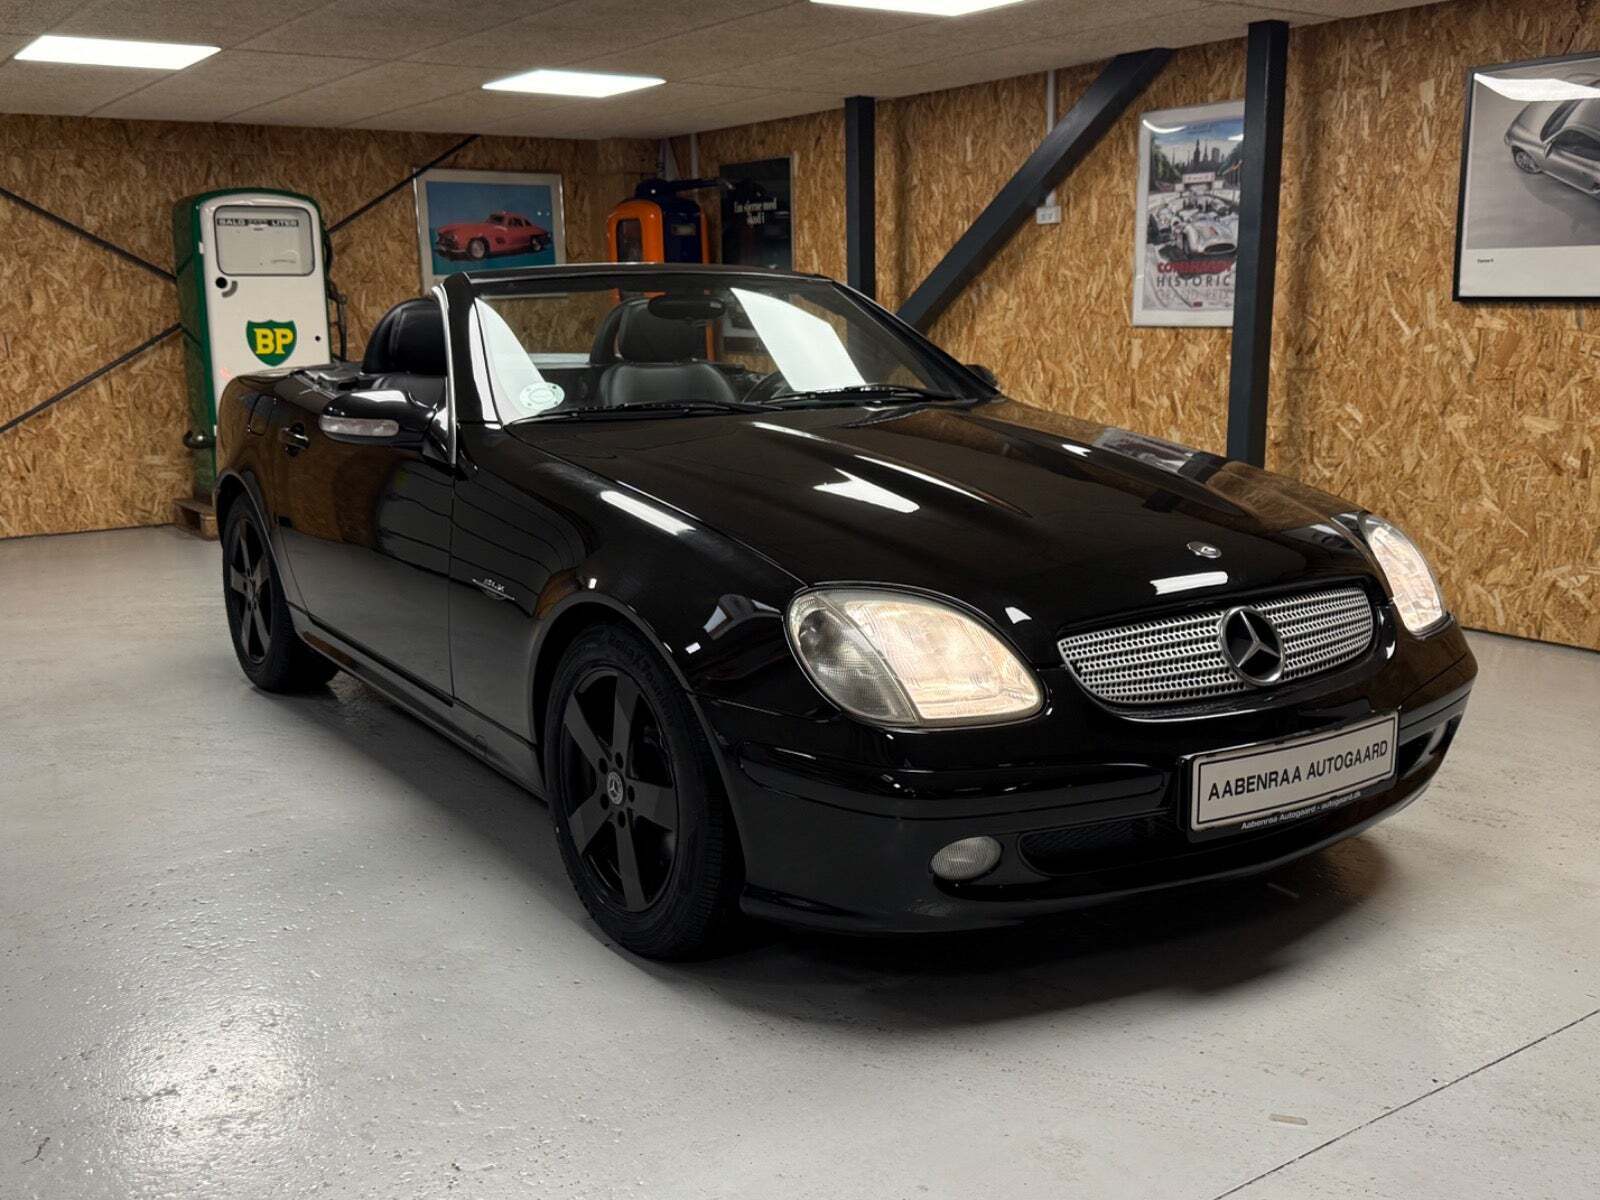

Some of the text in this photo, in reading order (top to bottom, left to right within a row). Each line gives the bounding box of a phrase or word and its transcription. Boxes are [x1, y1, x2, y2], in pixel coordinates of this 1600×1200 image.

[1156, 274, 1231, 287] HISTORIC
[253, 327, 294, 355] BP
[1207, 739, 1389, 801] AABENRAA AUTOGAARD
[1240, 815, 1278, 831] Aabenraa
[1279, 805, 1316, 822] Autogaard
